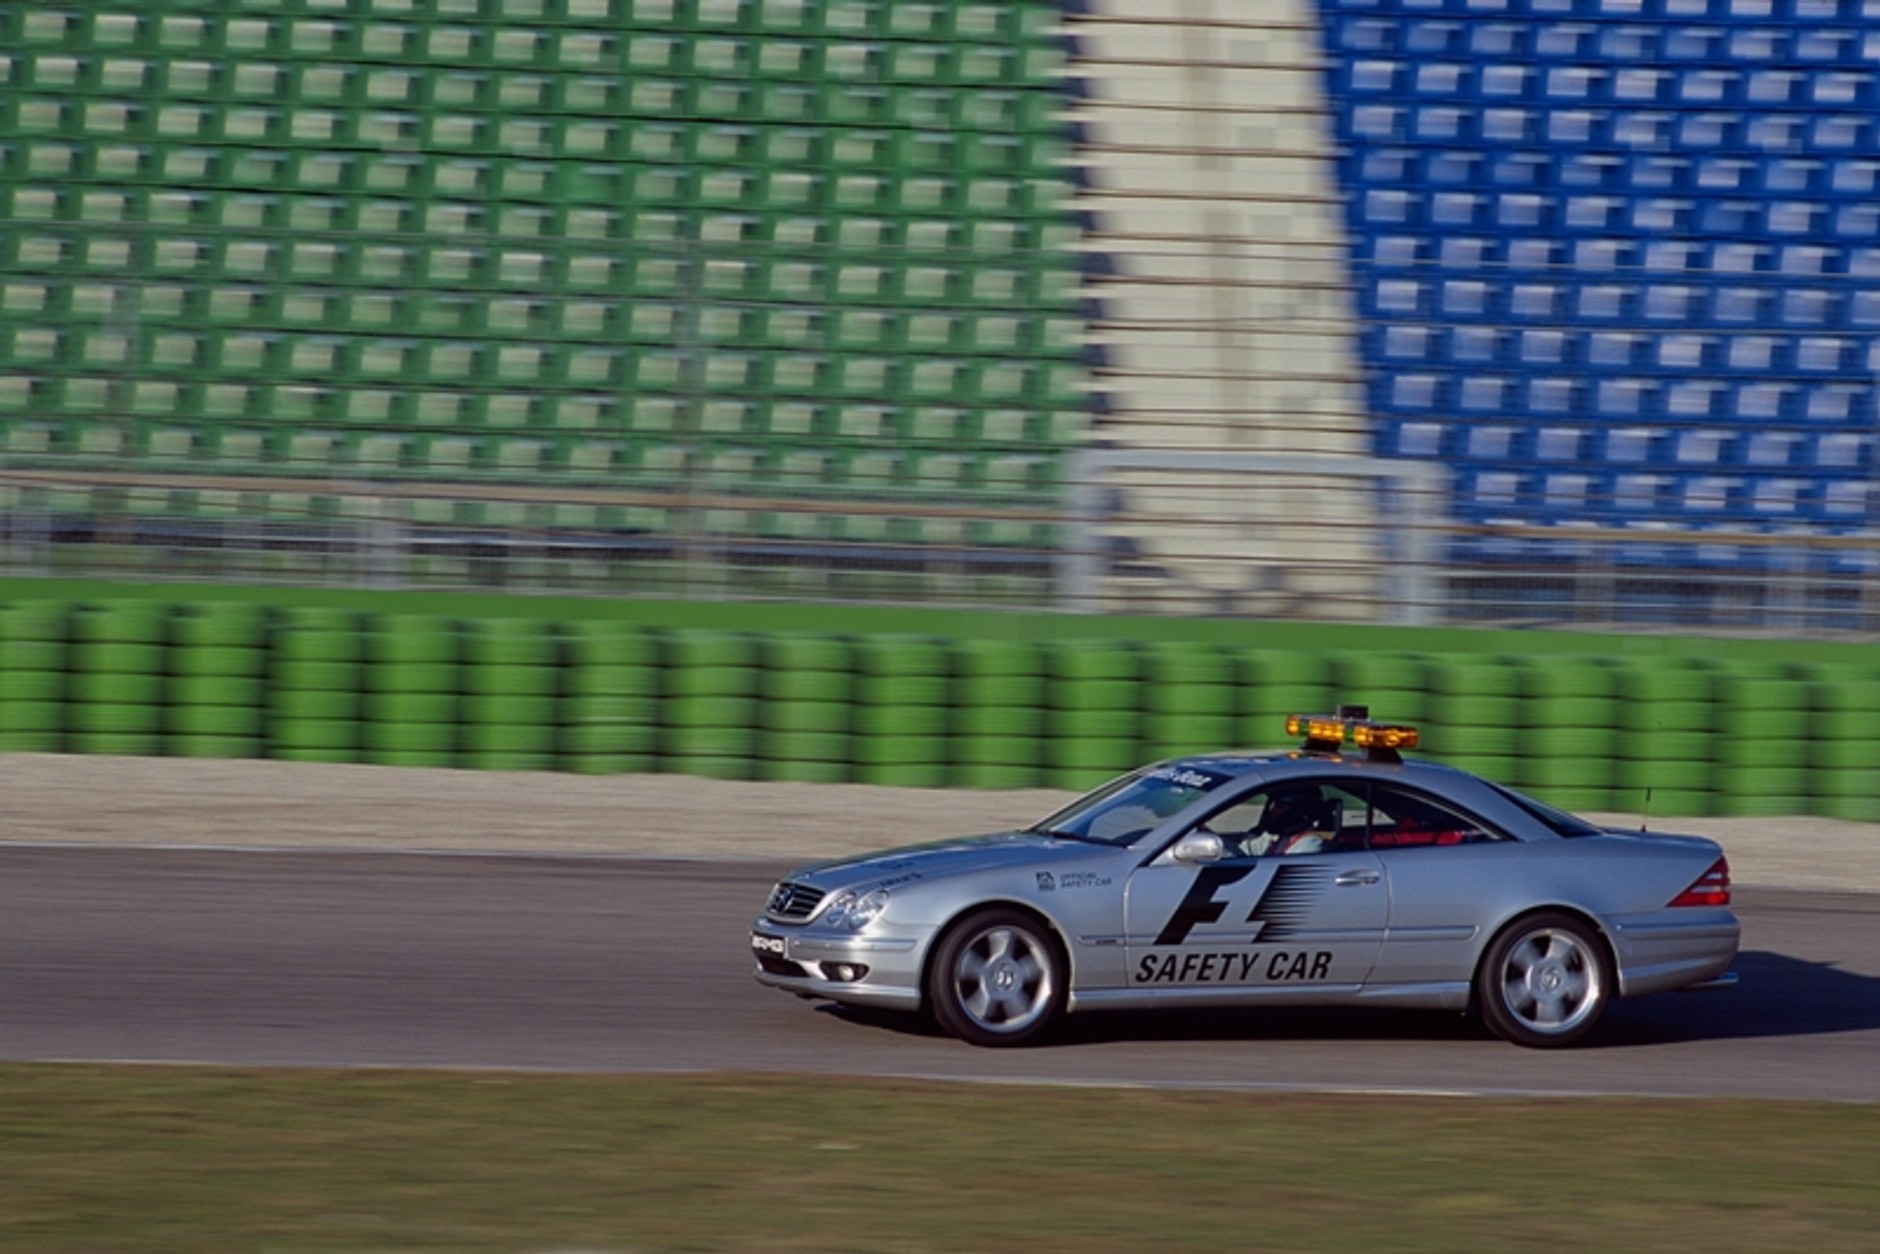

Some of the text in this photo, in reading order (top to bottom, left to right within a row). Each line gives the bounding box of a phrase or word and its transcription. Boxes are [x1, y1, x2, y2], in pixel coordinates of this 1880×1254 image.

[1060, 879, 1092, 888] SAFETY
[1095, 878, 1113, 886] CAR
[1153, 865, 1334, 945] F1
[1135, 951, 1333, 983] SAFETY CAR
